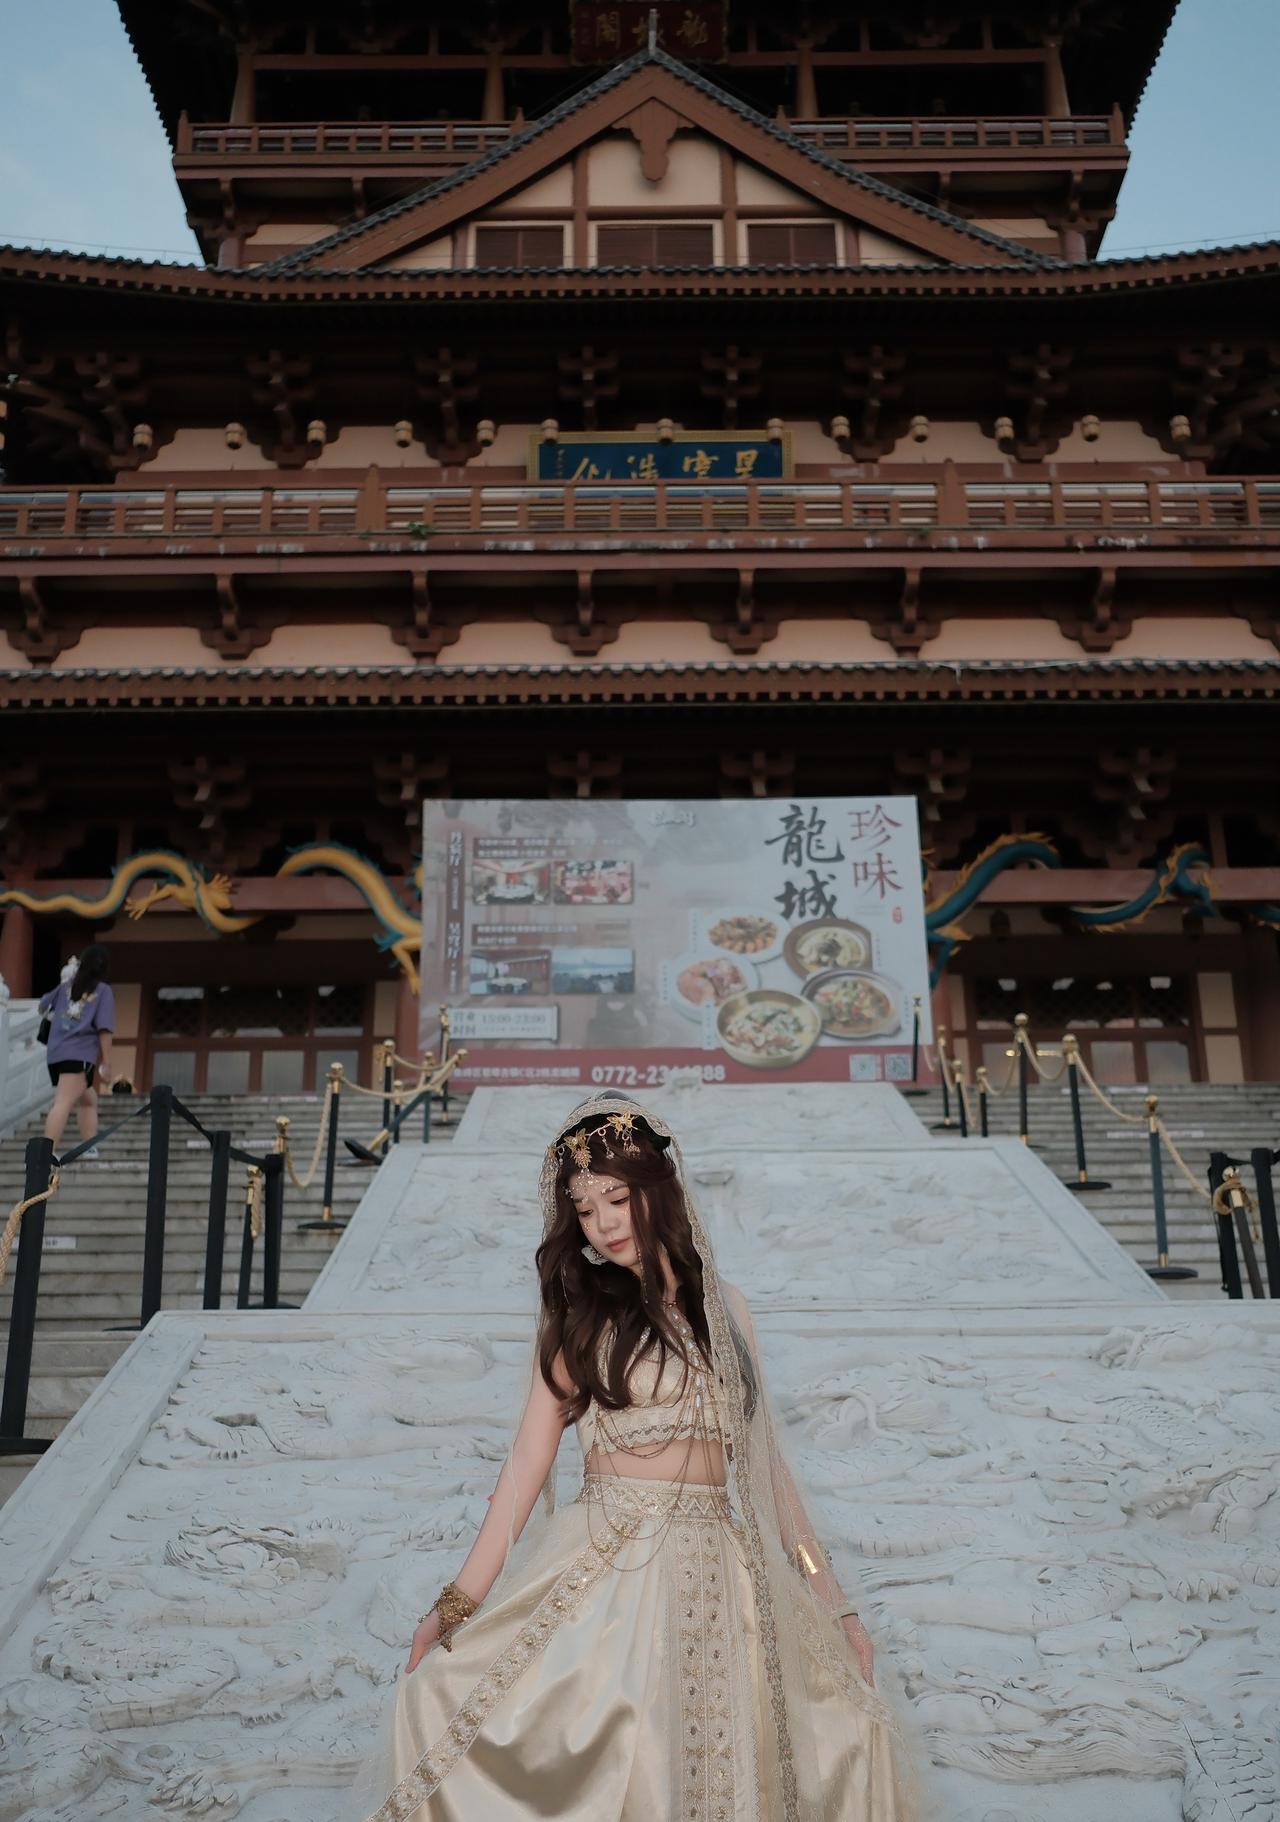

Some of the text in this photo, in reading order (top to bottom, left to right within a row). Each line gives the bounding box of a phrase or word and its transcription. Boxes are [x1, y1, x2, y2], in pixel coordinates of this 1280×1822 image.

[764, 804, 845, 920] 龍城
[847, 804, 903, 899] 珍味
[591, 1065, 726, 1086] 0772-2388
